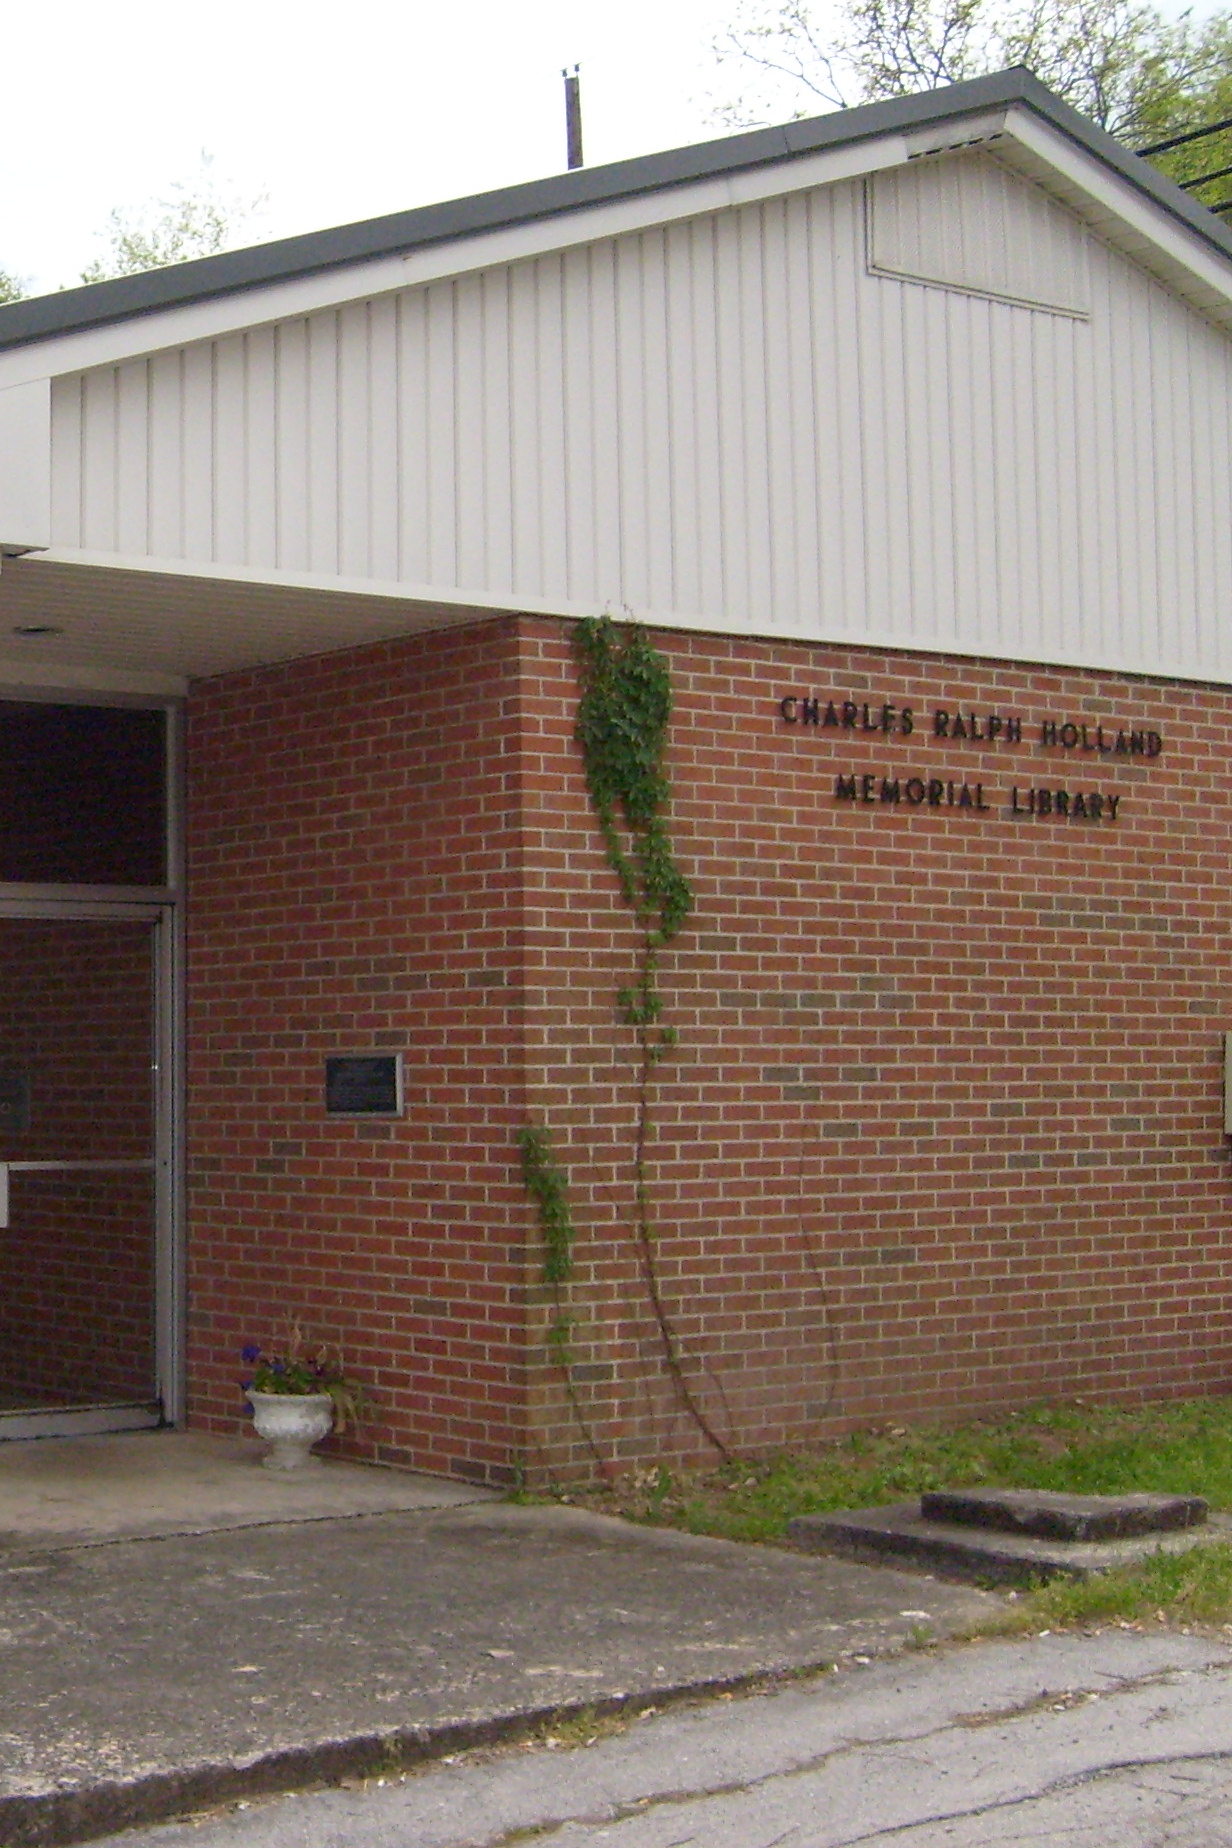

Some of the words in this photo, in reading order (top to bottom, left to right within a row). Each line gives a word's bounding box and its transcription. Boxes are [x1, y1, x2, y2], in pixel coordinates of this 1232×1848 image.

[780, 697, 914, 735] CHARLES
[934, 709, 1022, 743] RALPH
[1041, 720, 1163, 757] HOLLAND
[835, 774, 990, 812] MEMORIAL
[1012, 786, 1121, 820] LIBRARY
